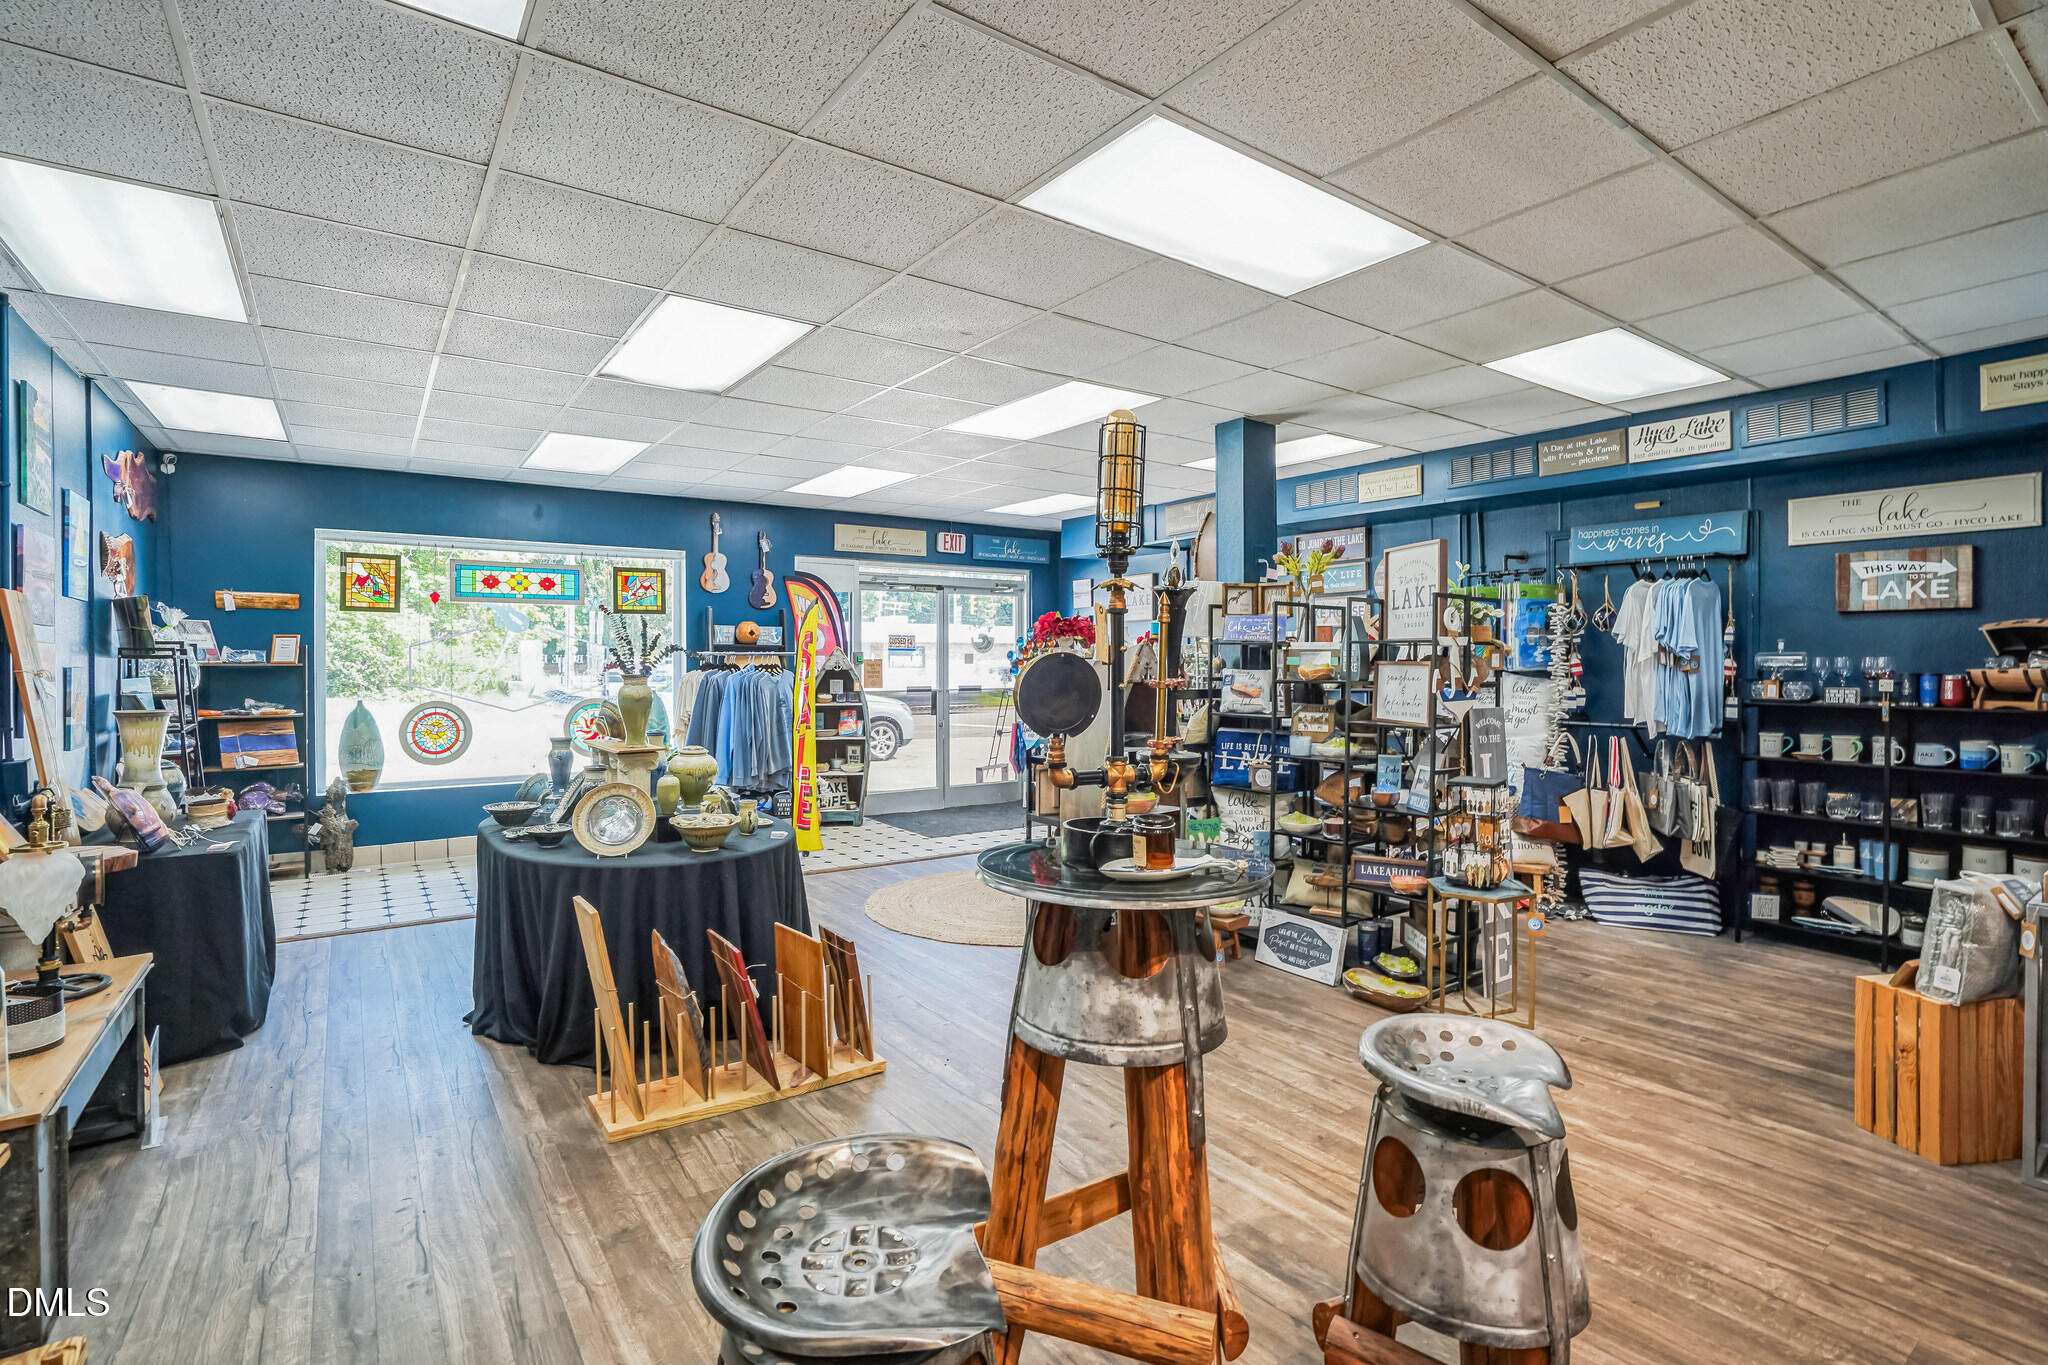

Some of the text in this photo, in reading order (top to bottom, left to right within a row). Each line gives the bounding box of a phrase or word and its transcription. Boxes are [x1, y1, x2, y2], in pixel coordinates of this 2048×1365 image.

[1989, 373, 2016, 384] What
[2012, 379, 2044, 391] Stays
[1633, 415, 1725, 453] Hyco Lake
[1551, 444, 1564, 453] Day
[1590, 437, 1608, 445] Lake
[1647, 448, 1671, 457] another
[1674, 446, 1685, 454] day
[1698, 440, 1726, 451] paradise
[1543, 455, 1556, 463] with
[1559, 451, 1584, 460] Friends
[1597, 444, 1620, 454] Family
[1579, 455, 1608, 466] priceless
[1840, 491, 1933, 526] THE lake
[1578, 523, 1659, 540] happiness comes in
[1801, 531, 1810, 539] IS
[1812, 527, 1856, 537] CALLING
[1860, 525, 1883, 534] AND
[1893, 522, 1922, 531] MUST
[1926, 519, 1943, 528] GO
[1954, 517, 1987, 526] HYCO
[1991, 514, 2023, 524] LAKE
[872, 529, 892, 546] lake
[943, 534, 963, 552] EXIT
[1298, 541, 1306, 550] GO
[1333, 535, 1346, 546] THE
[1347, 533, 1364, 544] LAKE
[1607, 531, 1666, 554] waves
[1005, 539, 1022, 556] lake
[1340, 569, 1362, 579] LIFE
[1863, 563, 1926, 575] THIS WAY
[1392, 584, 1436, 610] LAKE
[1861, 579, 1950, 601] LAKE
[1328, 606, 1364, 618] HOSE
[1251, 622, 1283, 632] watr
[1512, 681, 1536, 695] lake
[1512, 703, 1538, 715] must
[1475, 717, 1503, 729] WELCOME
[1514, 715, 1530, 729] go!
[1479, 734, 1502, 744] TO THE
[1221, 742, 1234, 750] LIFE
[1244, 743, 1267, 752] BETER
[1220, 751, 1291, 774] LAKE
[817, 782, 847, 794] LAKE
[817, 795, 847, 808] LIFE
[1228, 791, 1260, 808] lake
[1233, 818, 1267, 833] must
[1361, 864, 1420, 878] LAKEAHOLIC
[1244, 893, 1283, 908] AKE
[1269, 934, 1290, 949] Perfect
[1296, 932, 1313, 944] Lake
